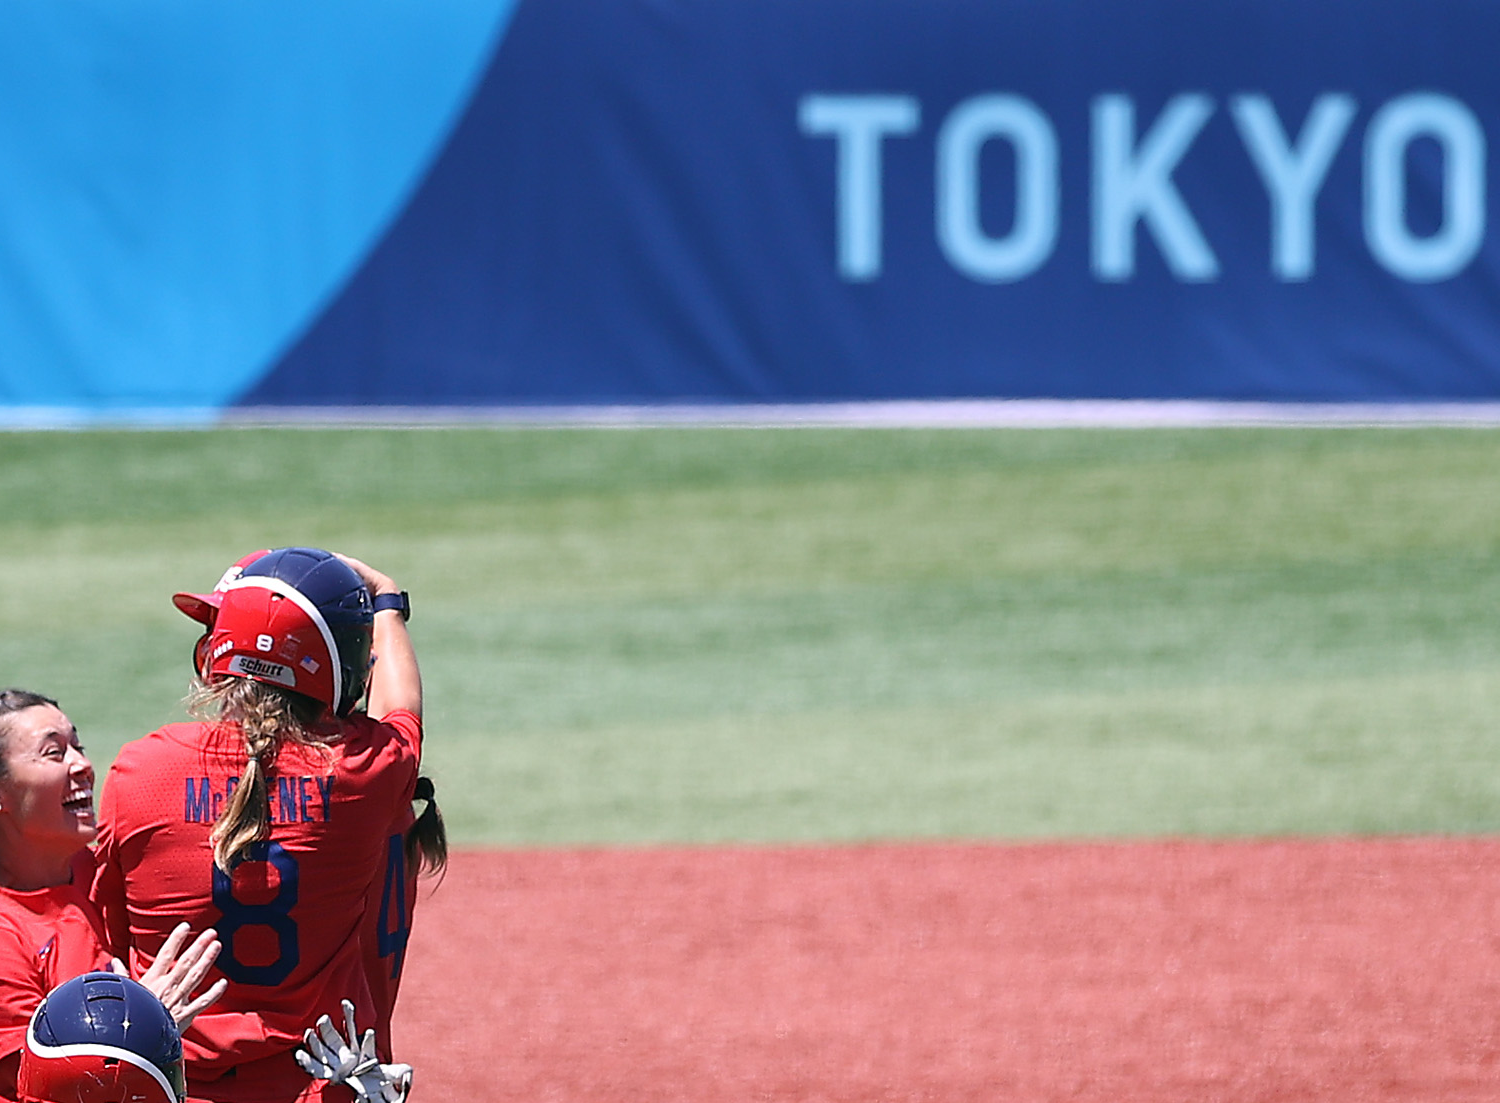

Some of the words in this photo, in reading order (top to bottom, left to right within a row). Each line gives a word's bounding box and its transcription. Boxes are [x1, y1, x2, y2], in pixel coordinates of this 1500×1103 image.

[799, 91, 1487, 284] TOKYO
[256, 633, 274, 652] 8
[185, 776, 335, 823] McENEY
[212, 840, 300, 987] 8
